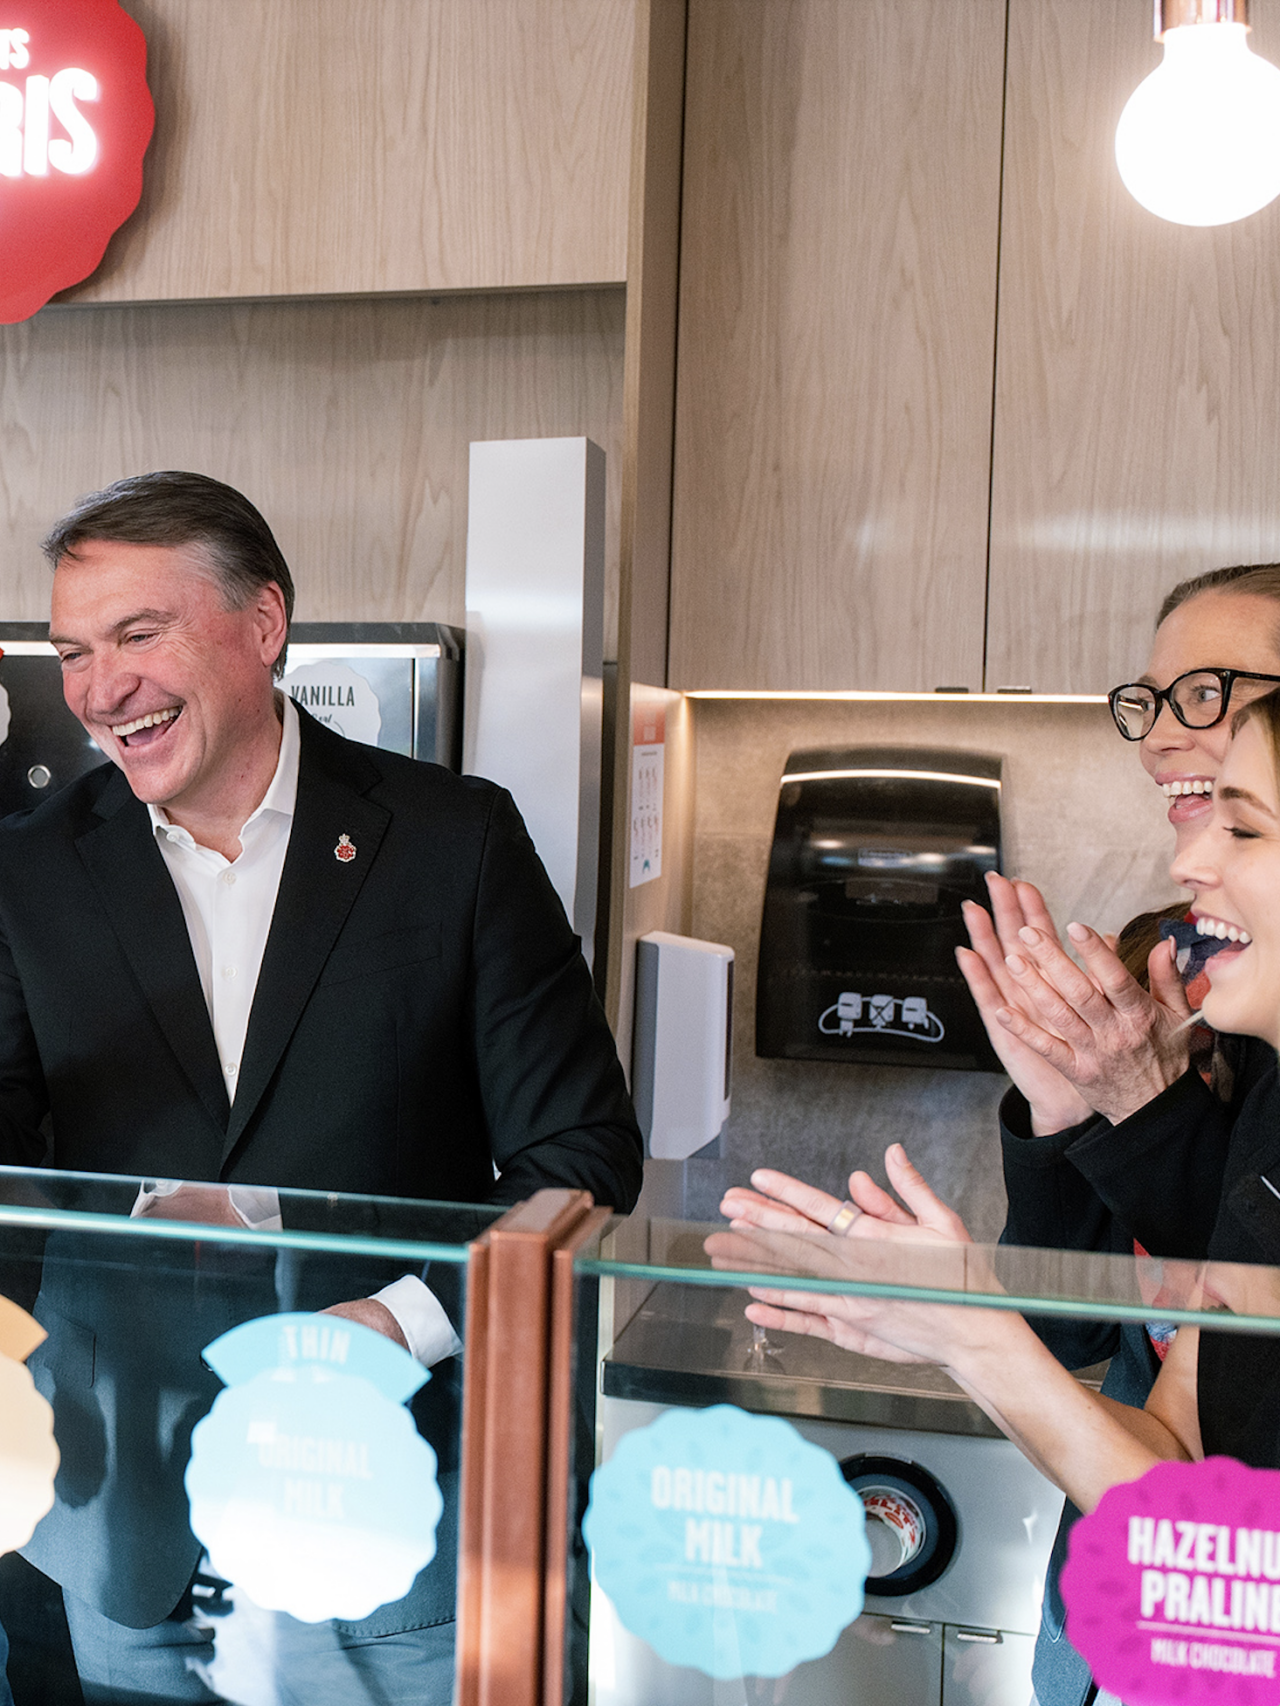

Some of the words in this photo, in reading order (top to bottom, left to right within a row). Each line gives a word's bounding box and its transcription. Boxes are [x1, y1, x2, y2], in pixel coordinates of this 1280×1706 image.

[291, 685, 355, 706] VANILLA
[282, 1324, 350, 1365] THIN
[282, 1477, 345, 1520] MILK
[650, 1466, 800, 1524] ORIGINAL
[684, 1517, 765, 1569] MILK
